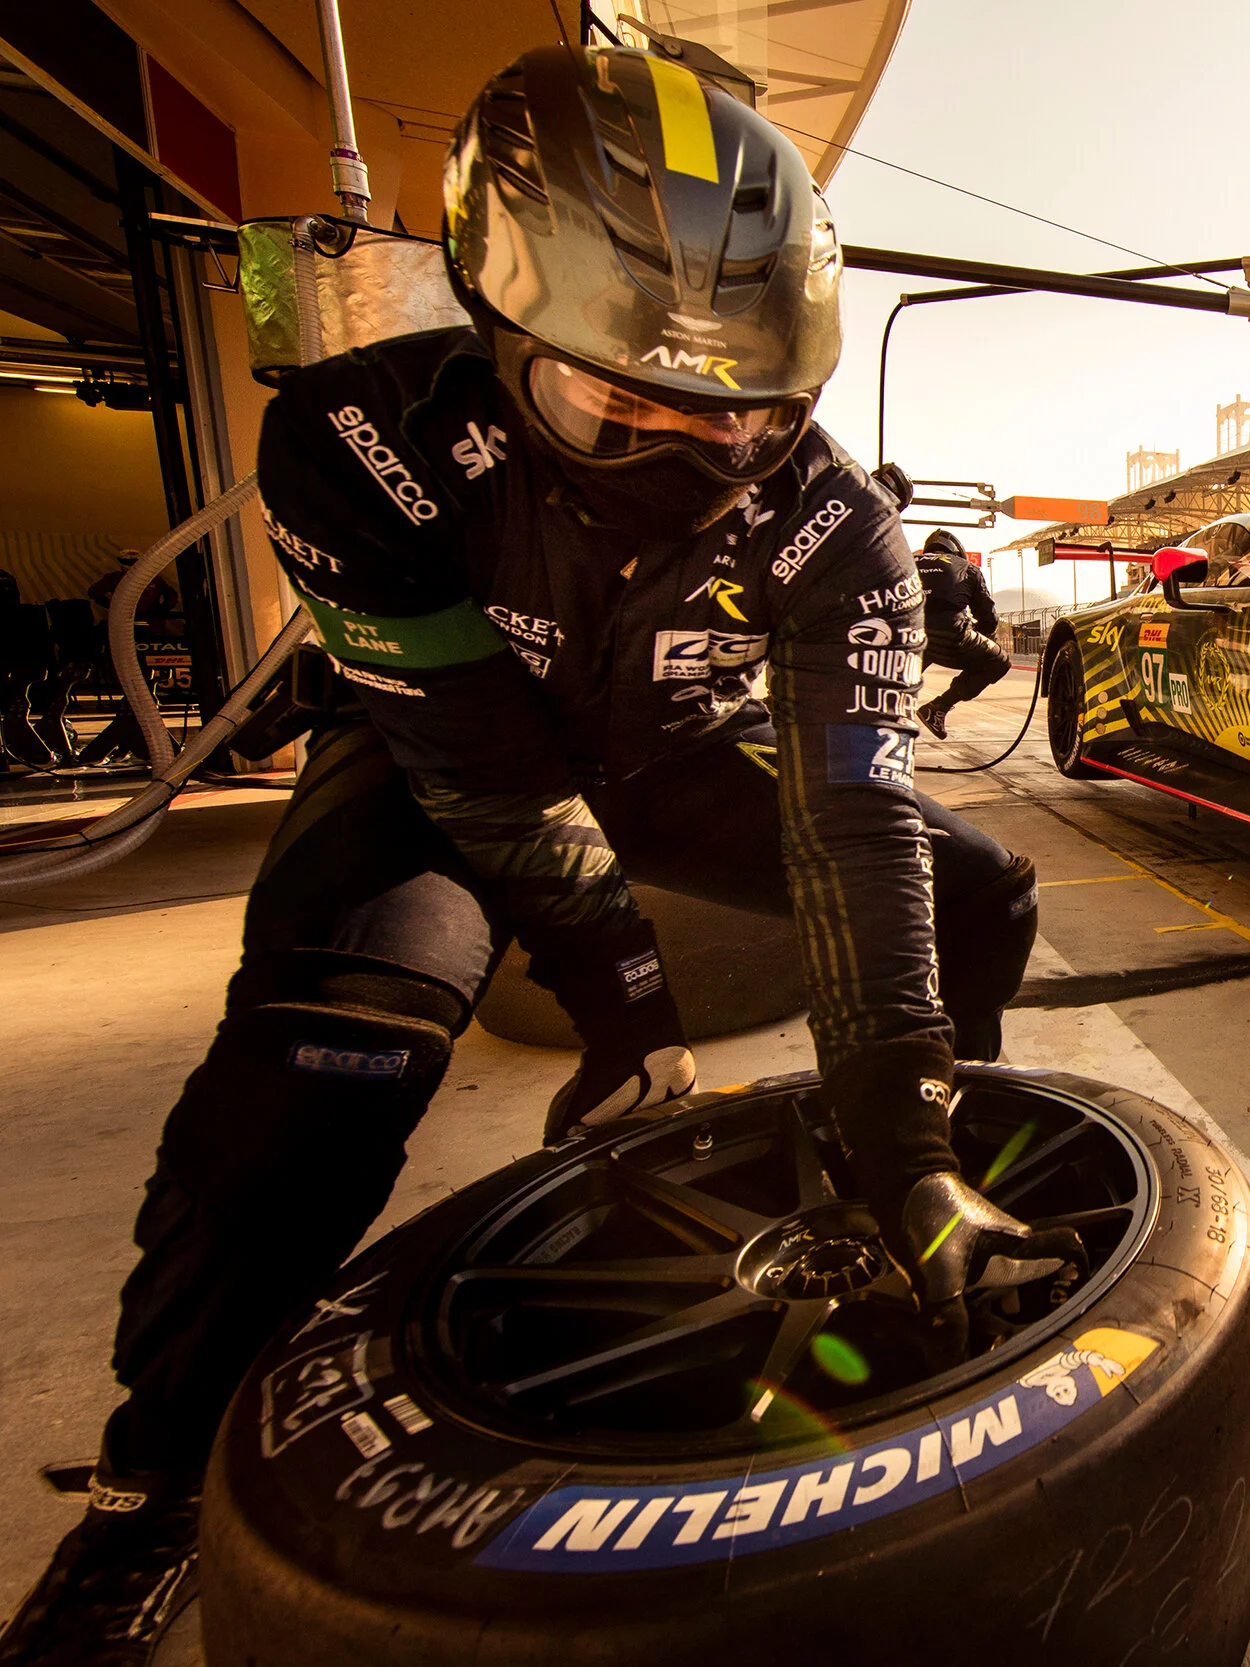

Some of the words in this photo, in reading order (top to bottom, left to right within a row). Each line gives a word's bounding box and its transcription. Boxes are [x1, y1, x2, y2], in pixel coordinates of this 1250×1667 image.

[661, 329, 690, 341] ASTON
[693, 336, 727, 348] MARTIN
[640, 345, 742, 391] AMR
[328, 405, 439, 526] sparco
[451, 421, 507, 480] sk
[1077, 501, 1102, 521] 98
[772, 499, 853, 584] sparco
[343, 620, 378, 637] PIT
[1087, 621, 1124, 652] sky
[135, 642, 189, 651] OTAL
[343, 633, 404, 655] LANE
[1141, 652, 1164, 704] 97
[1170, 679, 1190, 708] PRO
[869, 766, 890, 781] LE
[295, 1045, 402, 1074] sparco
[1171, 1147, 1193, 1180] RADIAL
[532, 1395, 1023, 1552] MICHELIN
